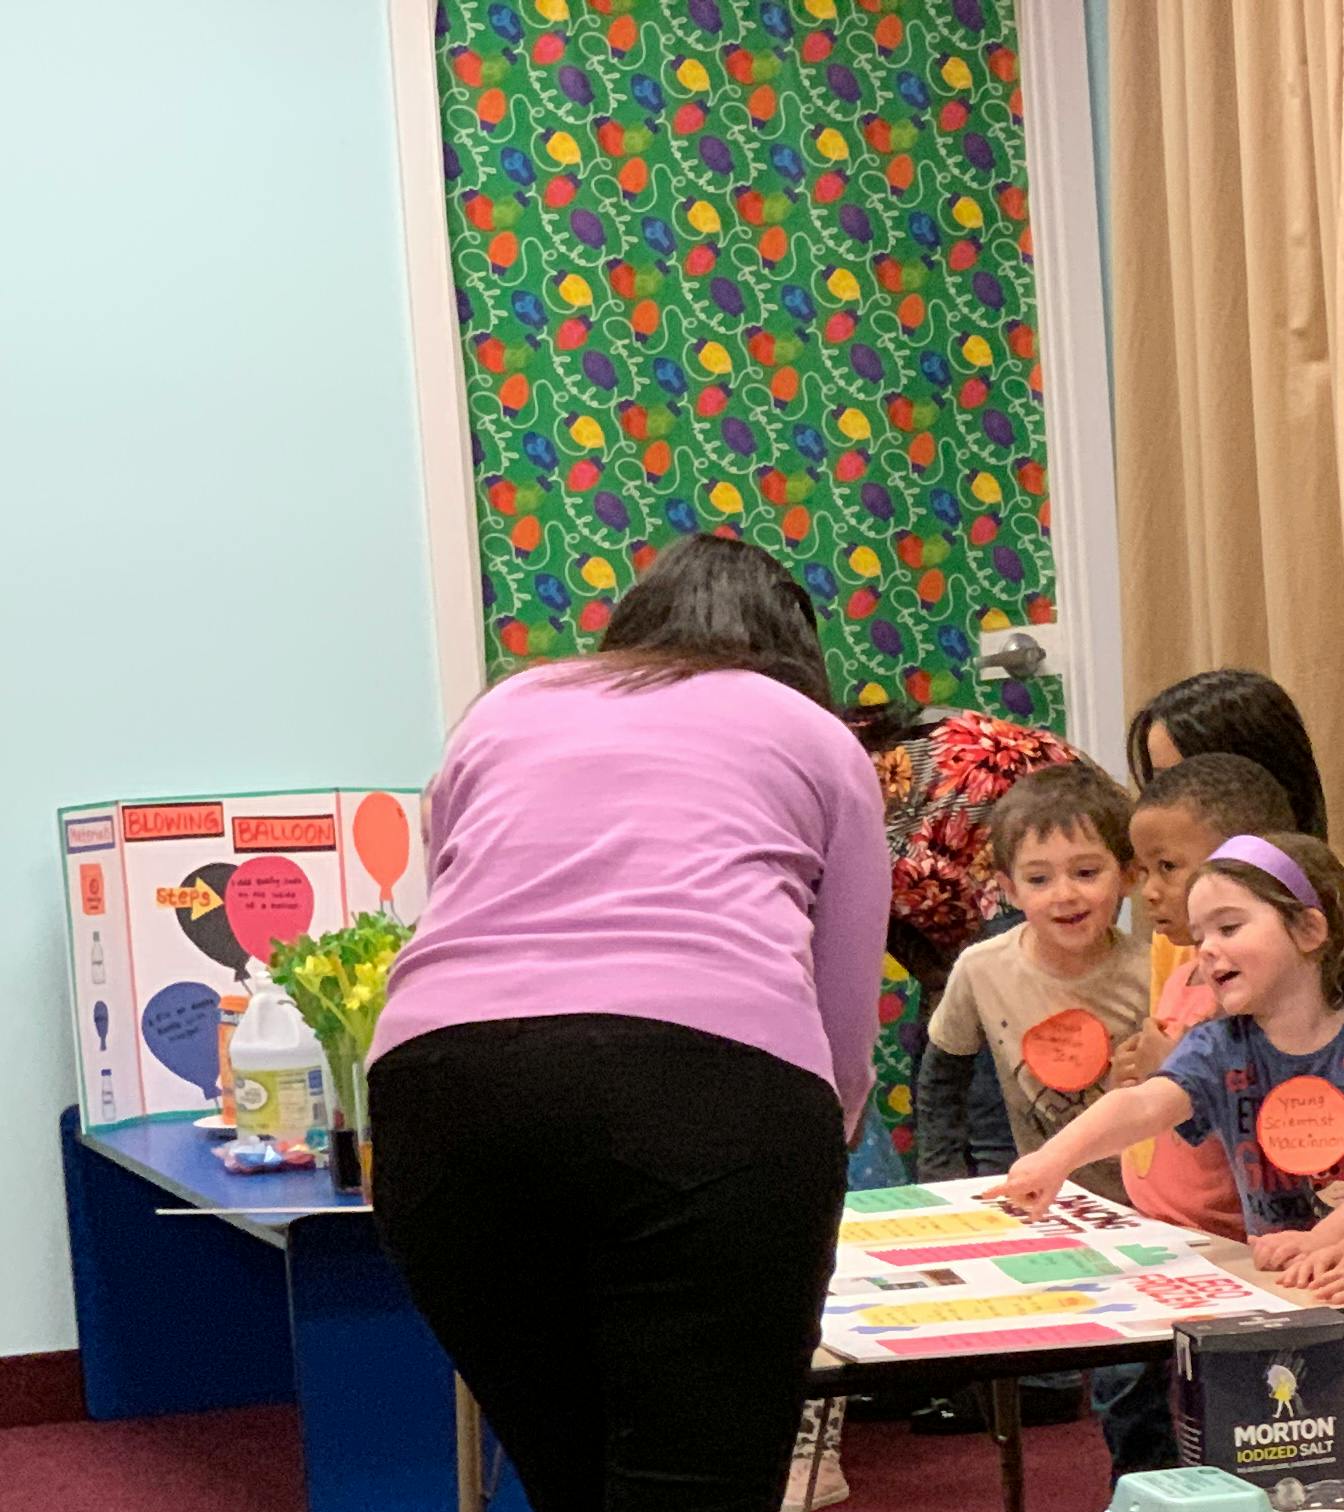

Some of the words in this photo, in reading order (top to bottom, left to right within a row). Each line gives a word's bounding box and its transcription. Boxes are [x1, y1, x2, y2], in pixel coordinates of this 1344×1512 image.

[126, 813, 220, 836] BLOWING
[238, 822, 332, 845] BALLOON
[1118, 1273, 1219, 1310] FROZEN
[1173, 1273, 1254, 1299] LEGO
[1234, 1416, 1335, 1447] MORTON
[1237, 1445, 1297, 1463] IODIZED
[1300, 1440, 1334, 1457] SALT
